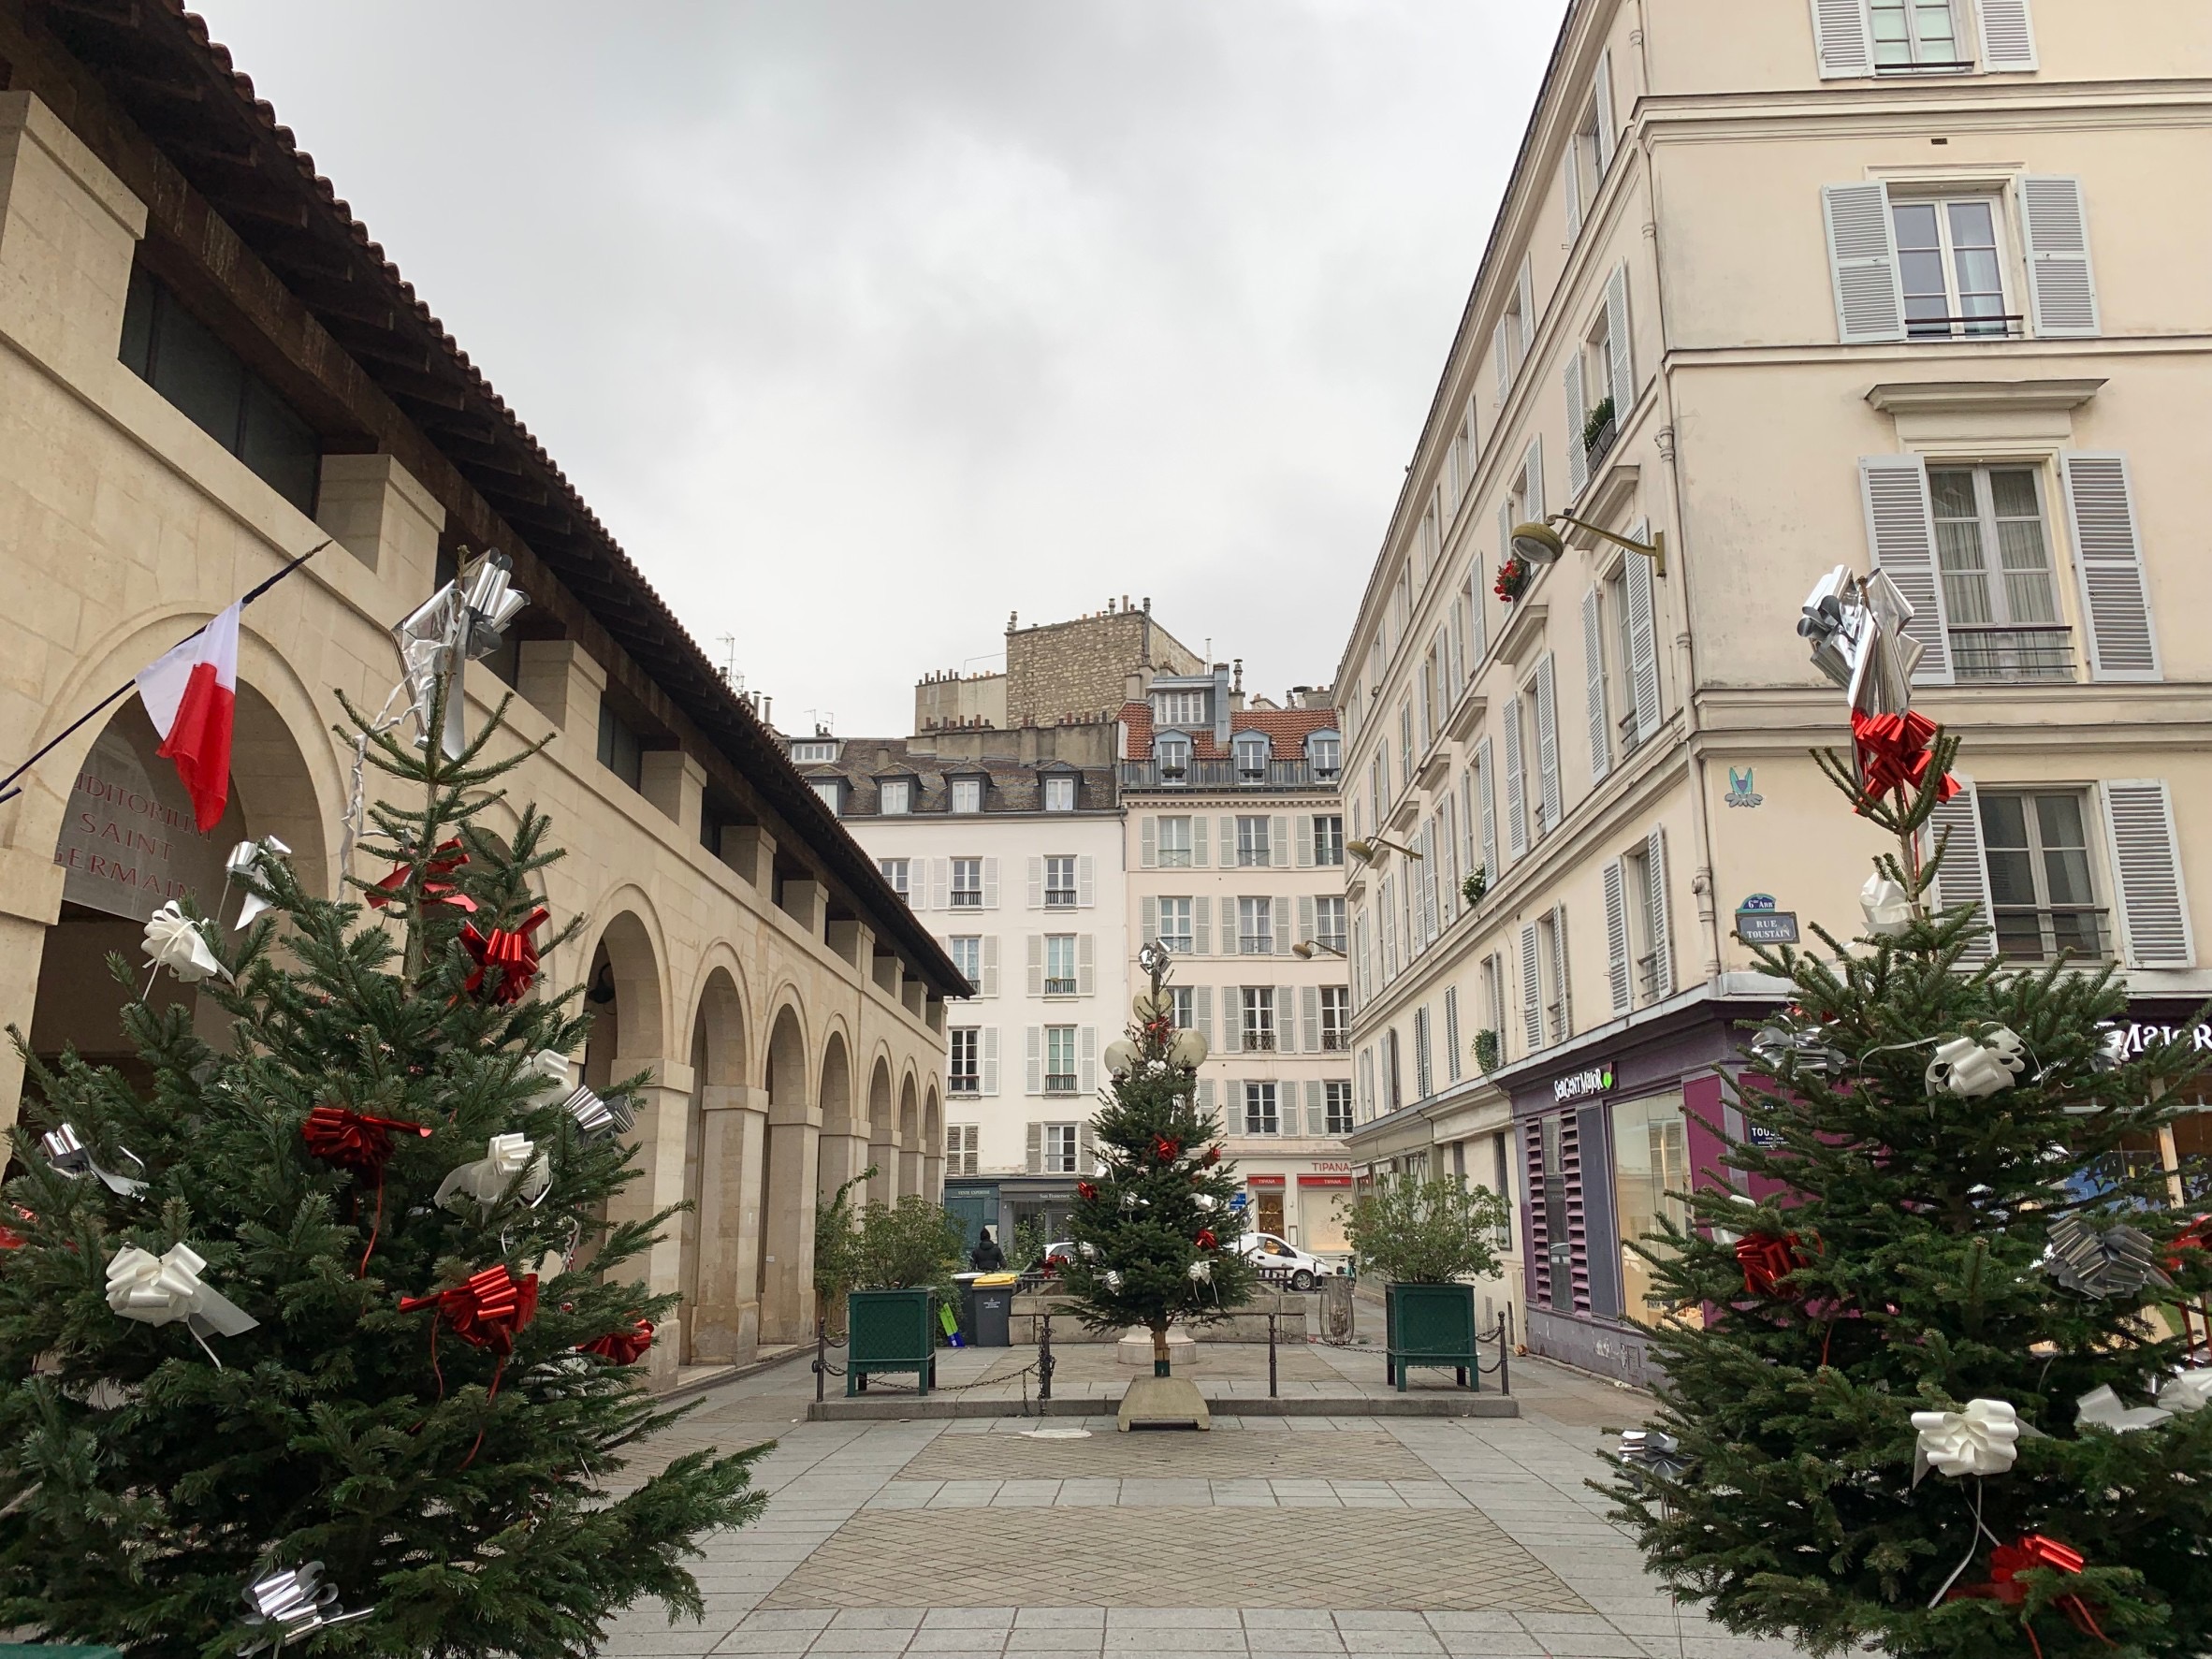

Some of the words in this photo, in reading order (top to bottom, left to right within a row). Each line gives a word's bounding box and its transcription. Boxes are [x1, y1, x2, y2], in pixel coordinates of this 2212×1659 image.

[80, 813, 175, 862] SAINT
[1755, 920, 1778, 928] RUE
[1746, 929, 1791, 939] TOUSTAIN
[1312, 1162, 1349, 1172] TIPANA
